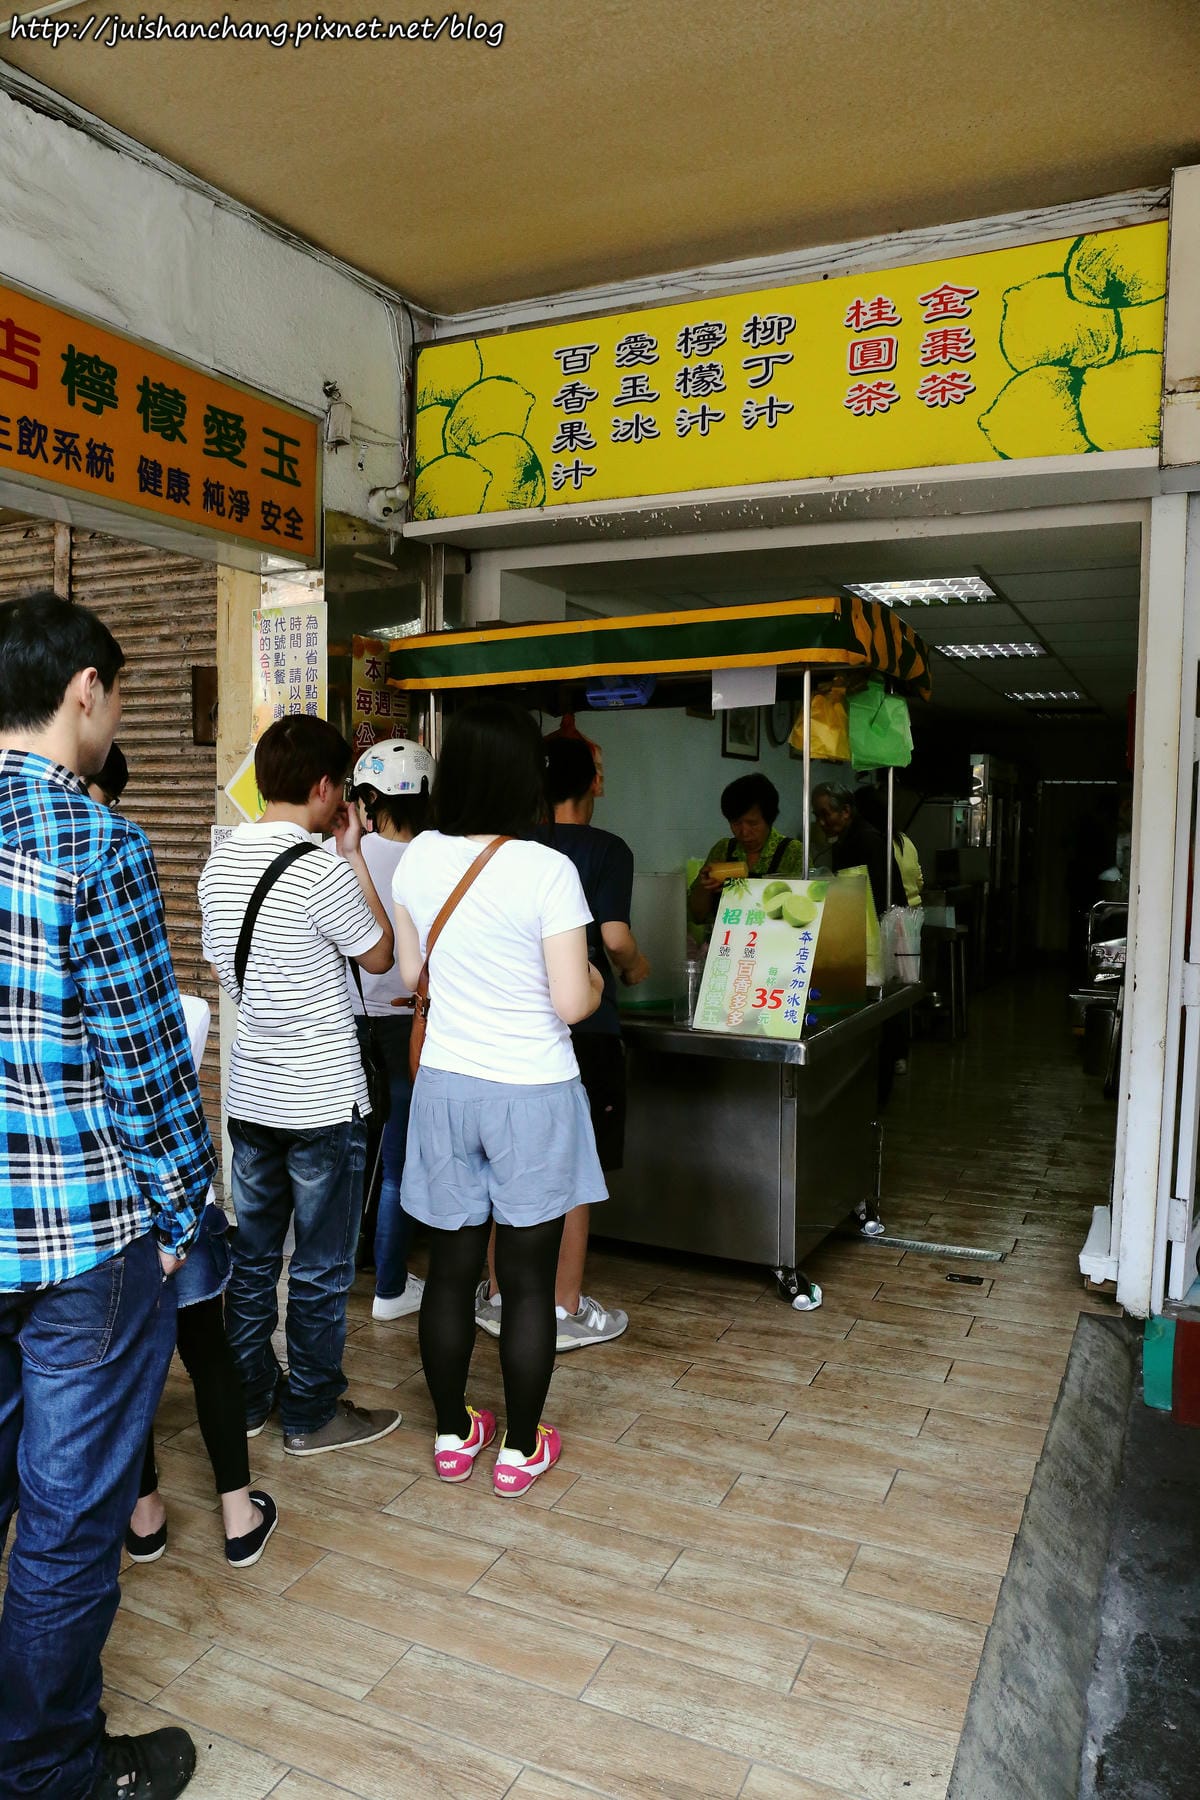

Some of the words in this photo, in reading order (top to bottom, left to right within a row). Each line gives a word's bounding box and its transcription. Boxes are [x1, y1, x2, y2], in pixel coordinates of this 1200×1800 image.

[611, 333, 661, 443] 愛玉冰
[676, 321, 727, 436] 檸檬汁
[742, 314, 797, 428] 柳丁汁
[844, 296, 901, 416] 桂圓茶
[918, 283, 979, 408] 金棗茶
[61, 343, 302, 488] 檸檬愛玉
[551, 343, 599, 489] 百香果汁
[137, 454, 191, 506] 健康
[202, 477, 250, 523] 純淨
[260, 500, 304, 541] 安全
[356, 688, 408, 718] 每週三
[726, 959, 756, 1027] 百香多多
[751, 987, 785, 1010] 35
[784, 931, 812, 1024] 本店不加冰塊
